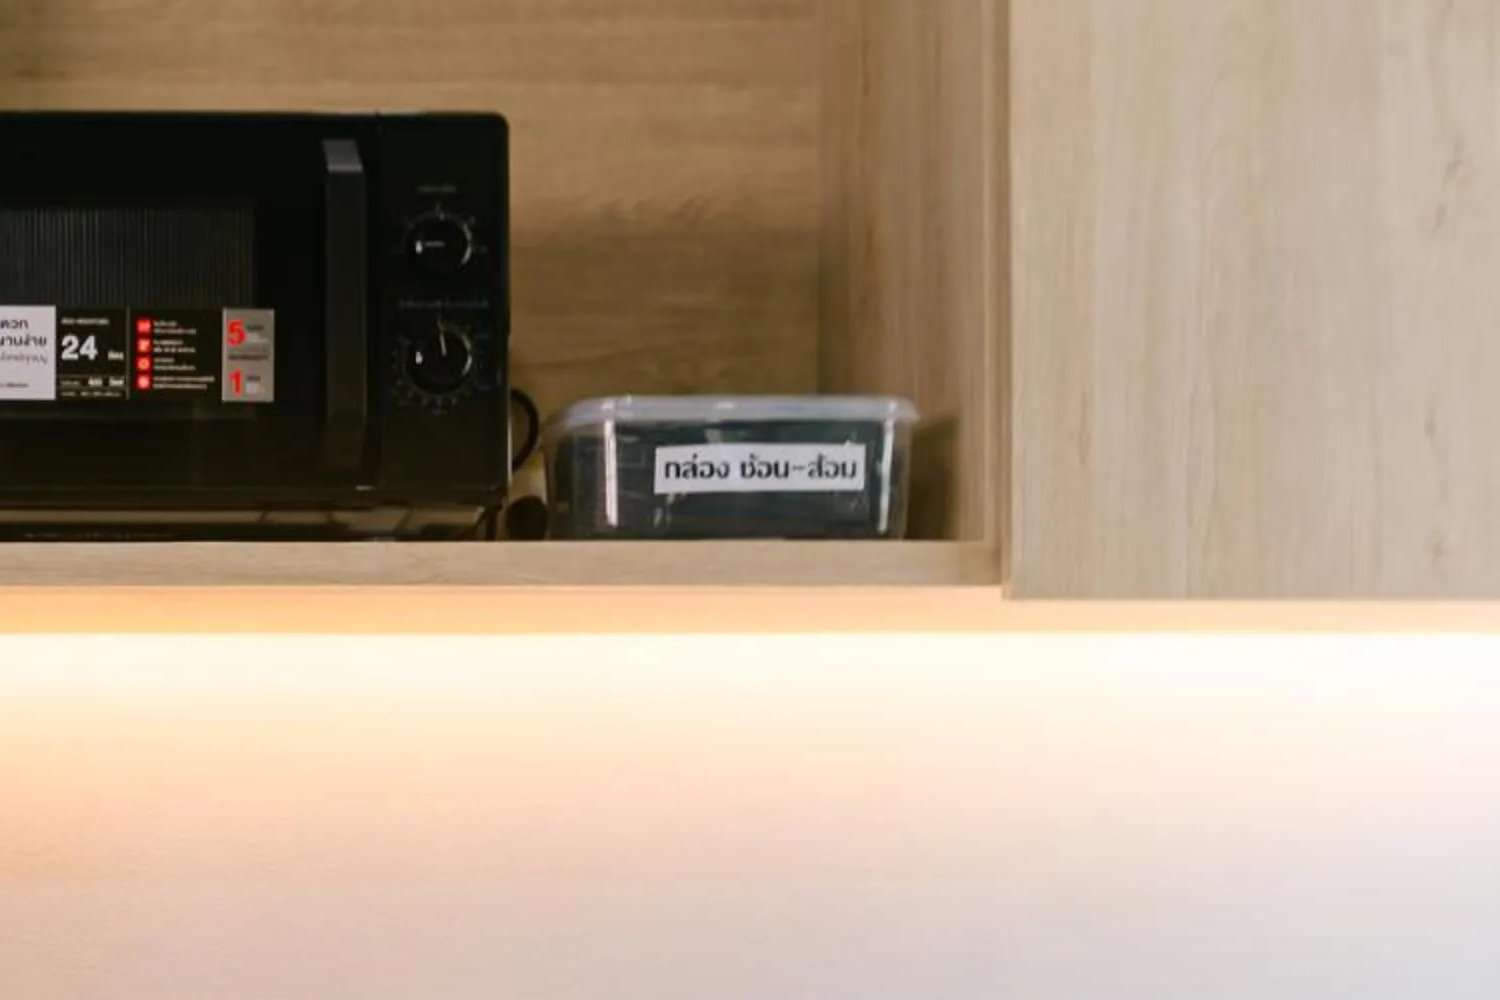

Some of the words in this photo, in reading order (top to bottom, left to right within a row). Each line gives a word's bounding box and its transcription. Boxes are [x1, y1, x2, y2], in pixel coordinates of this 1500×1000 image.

[228, 320, 246, 346] 5
[61, 335, 98, 360] 24
[229, 369, 242, 397] 1
[665, 452, 730, 480] กล่อง
